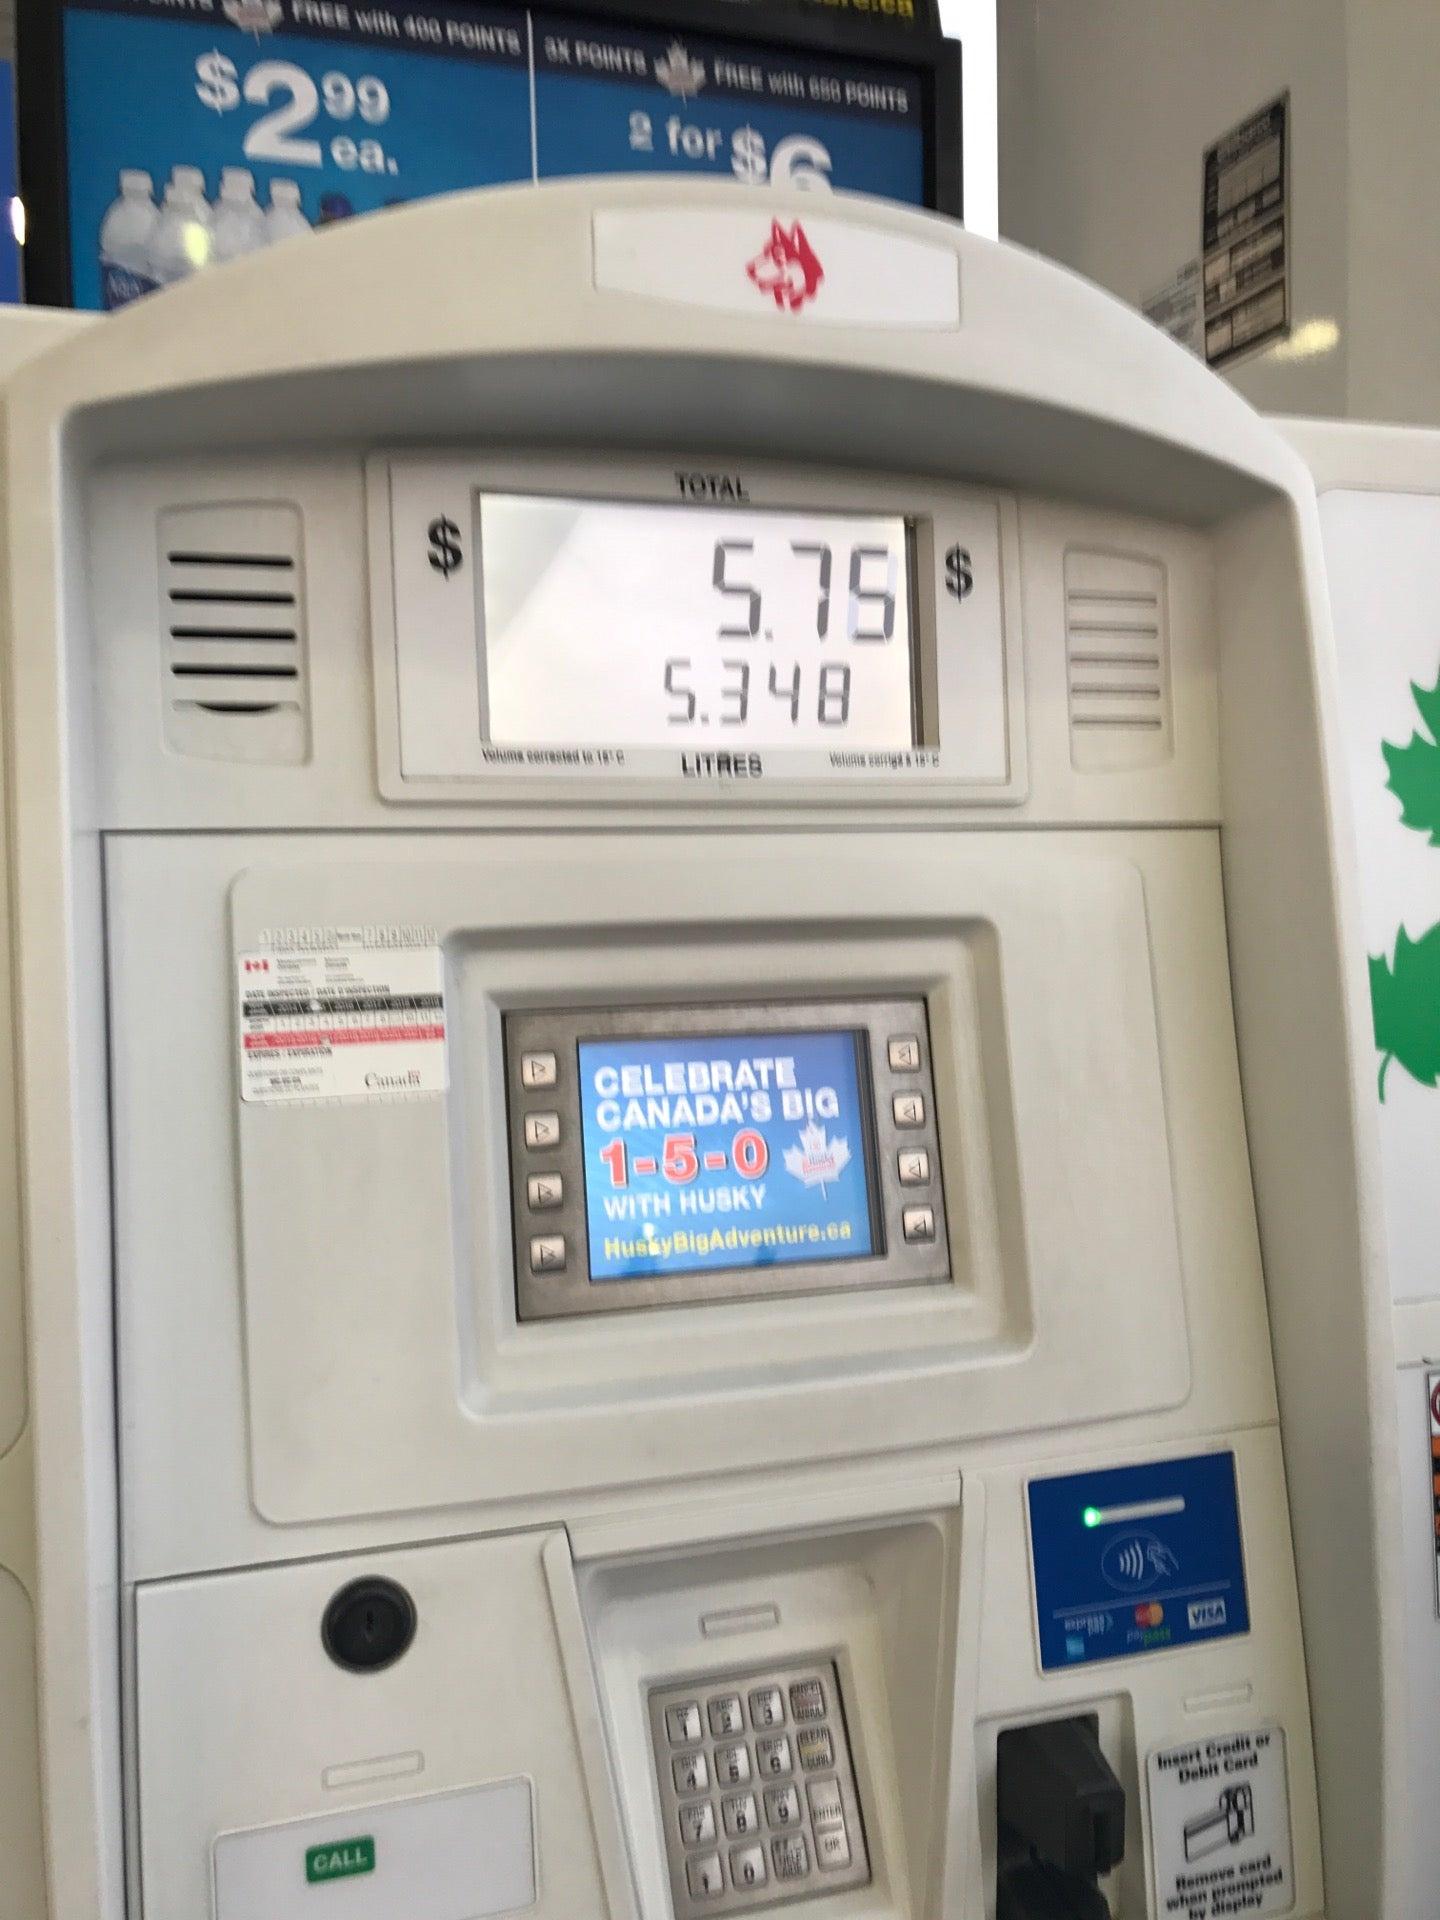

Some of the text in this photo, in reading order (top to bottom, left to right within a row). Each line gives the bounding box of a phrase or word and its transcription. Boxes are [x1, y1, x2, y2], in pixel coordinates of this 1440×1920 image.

[291, 0, 350, 30] FREE
[446, 19, 521, 56] POINTS
[574, 39, 648, 76] POINTS
[845, 80, 909, 113] POINTS
[666, 114, 723, 162] for
[674, 469, 751, 503] TOTAL
[426, 514, 464, 581] $
[944, 542, 974, 603] $
[664, 656, 852, 728] 5.348
[681, 750, 763, 778] LITRES
[594, 1056, 798, 1098] CELEBRATE
[596, 1086, 840, 1132] CANADA'S BIG
[599, 1127, 770, 1189] 1-5-0
[603, 1183, 767, 1221] WITH HUSKY
[604, 1219, 852, 1261] HuskyBigAdventure.ca
[1190, 1603, 1224, 1623] VISA
[1157, 1733, 1270, 1771] Insert Credit or
[1179, 1751, 1258, 1784] Debit Card
[312, 1846, 369, 1873] CALL
[1176, 1852, 1271, 1891] Remove card
[1166, 1866, 1283, 1911] when prompted
[1211, 1893, 1263, 1917] display
